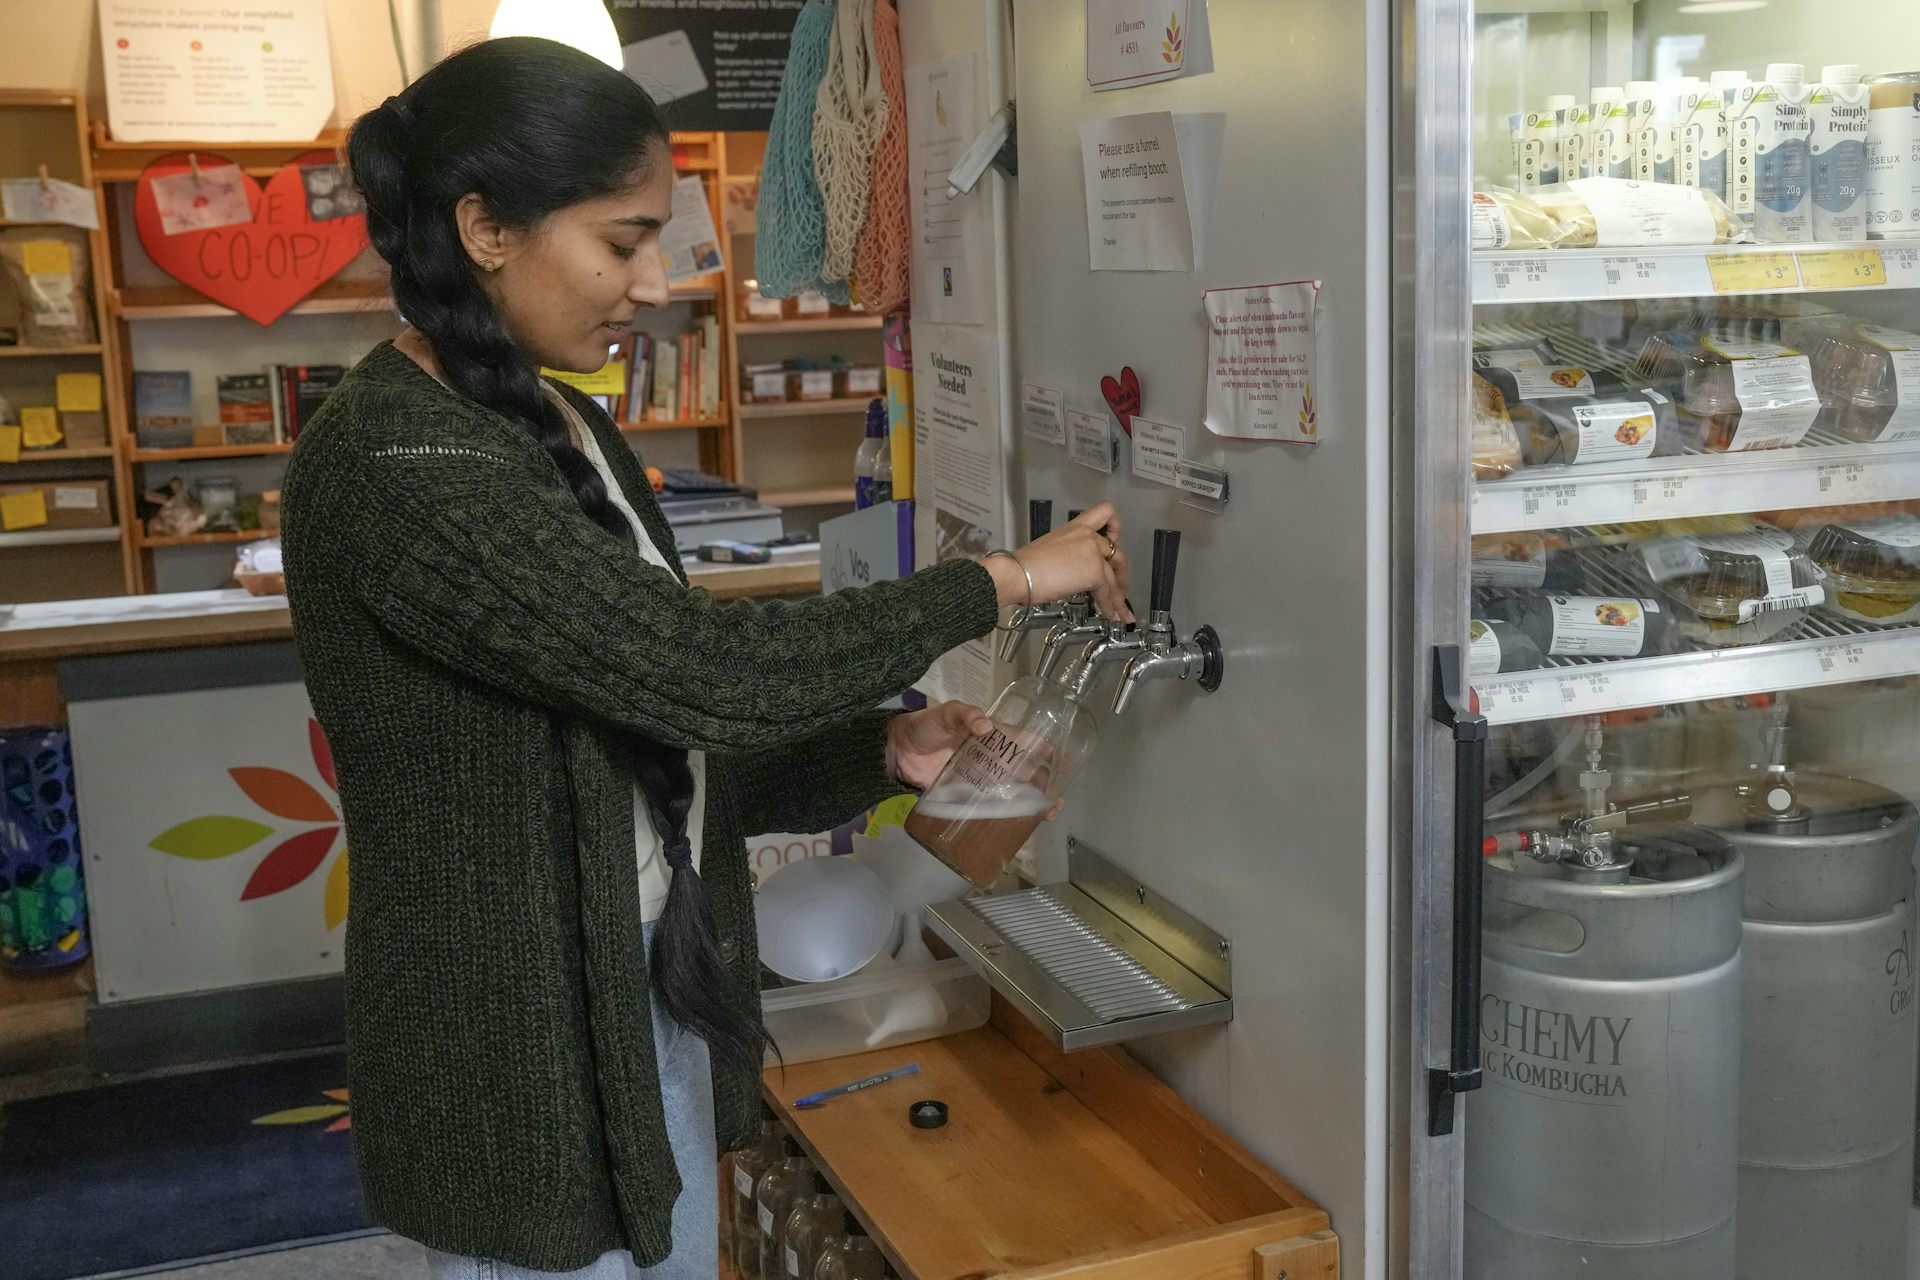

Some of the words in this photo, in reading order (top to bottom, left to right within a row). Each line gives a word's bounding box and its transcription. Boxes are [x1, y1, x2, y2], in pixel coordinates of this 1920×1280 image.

[1122, 20, 1146, 33] flavours
[1775, 104, 1807, 119] Simply
[1831, 106, 1867, 120] Simply
[1774, 120, 1809, 131] Protein
[1829, 121, 1868, 132] Protein
[1098, 143, 1122, 157] Please
[1123, 144, 1135, 154] use
[1140, 137, 1160, 153] funnel
[1100, 164, 1120, 179] when
[1122, 163, 1148, 179] refilling
[200, 231, 330, 282] CO-OP!
[930, 351, 973, 378] Volunteers
[937, 373, 966, 395] Needed
[849, 548, 870, 583] Vos
[976, 728, 1024, 765] HEMY
[966, 743, 1008, 780] COMPANY
[745, 838, 833, 871] OOD
[1480, 992, 1634, 1068] CHEMY
[1501, 1052, 1628, 1098] KOMBUCHA
